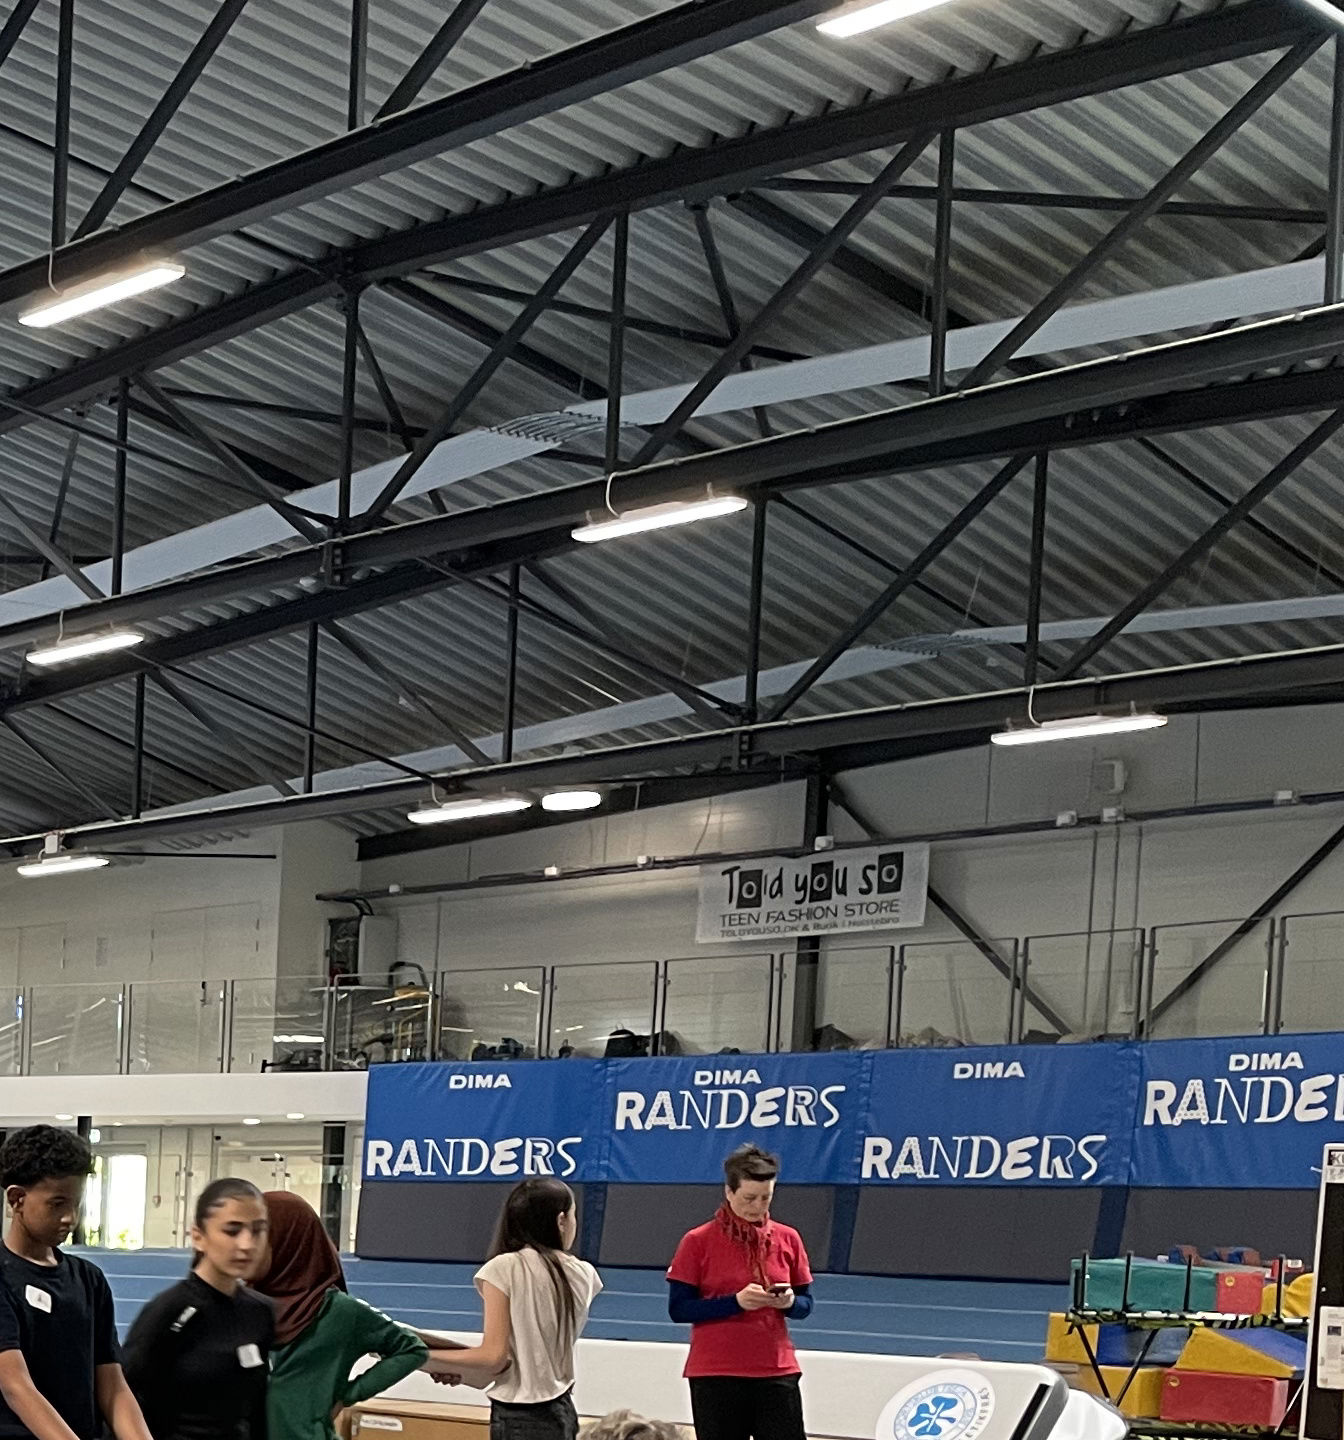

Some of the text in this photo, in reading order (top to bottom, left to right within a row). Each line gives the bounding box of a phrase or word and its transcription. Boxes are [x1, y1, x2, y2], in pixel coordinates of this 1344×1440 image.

[719, 898, 901, 928] TEEN FASHION STORE
[953, 1061, 1026, 1080] DIMA
[1228, 1051, 1304, 1072] DIMA
[448, 1072, 513, 1090] DIMA
[693, 1068, 763, 1087] DIMA
[615, 1084, 847, 1131] RANDERS
[366, 1136, 583, 1177] RANDERS
[861, 1134, 1107, 1181] RANDERS
